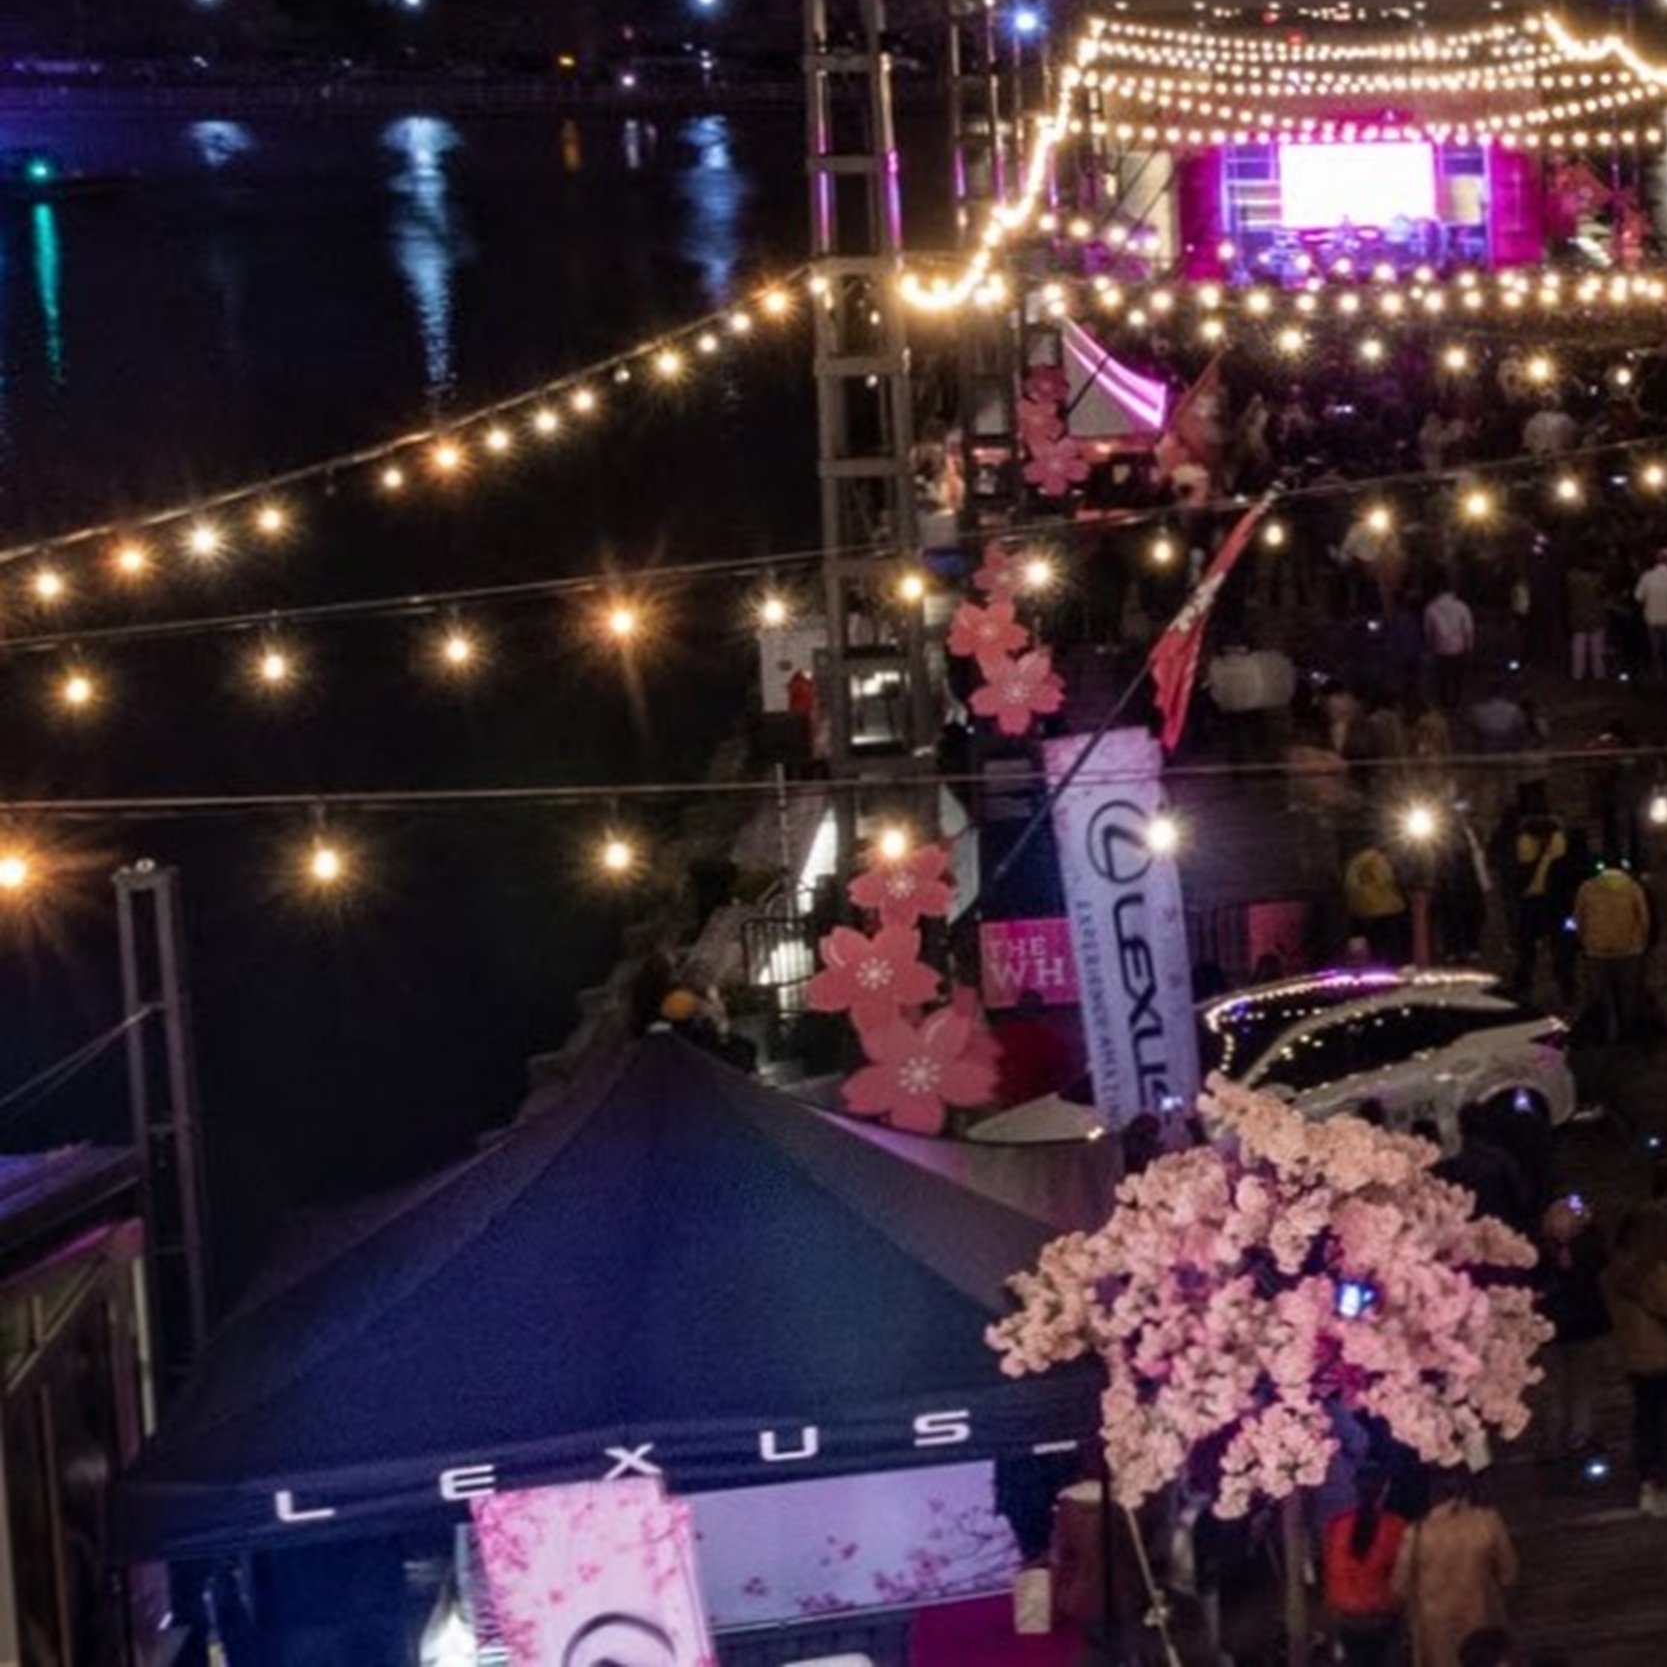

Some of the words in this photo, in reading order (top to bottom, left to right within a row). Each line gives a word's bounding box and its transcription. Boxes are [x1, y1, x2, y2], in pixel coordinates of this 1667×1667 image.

[986, 935, 1047, 961] THE
[988, 956, 1077, 988] WH
[1112, 892, 1174, 1124] LEXUS
[273, 1409, 971, 1523] LEXUS
